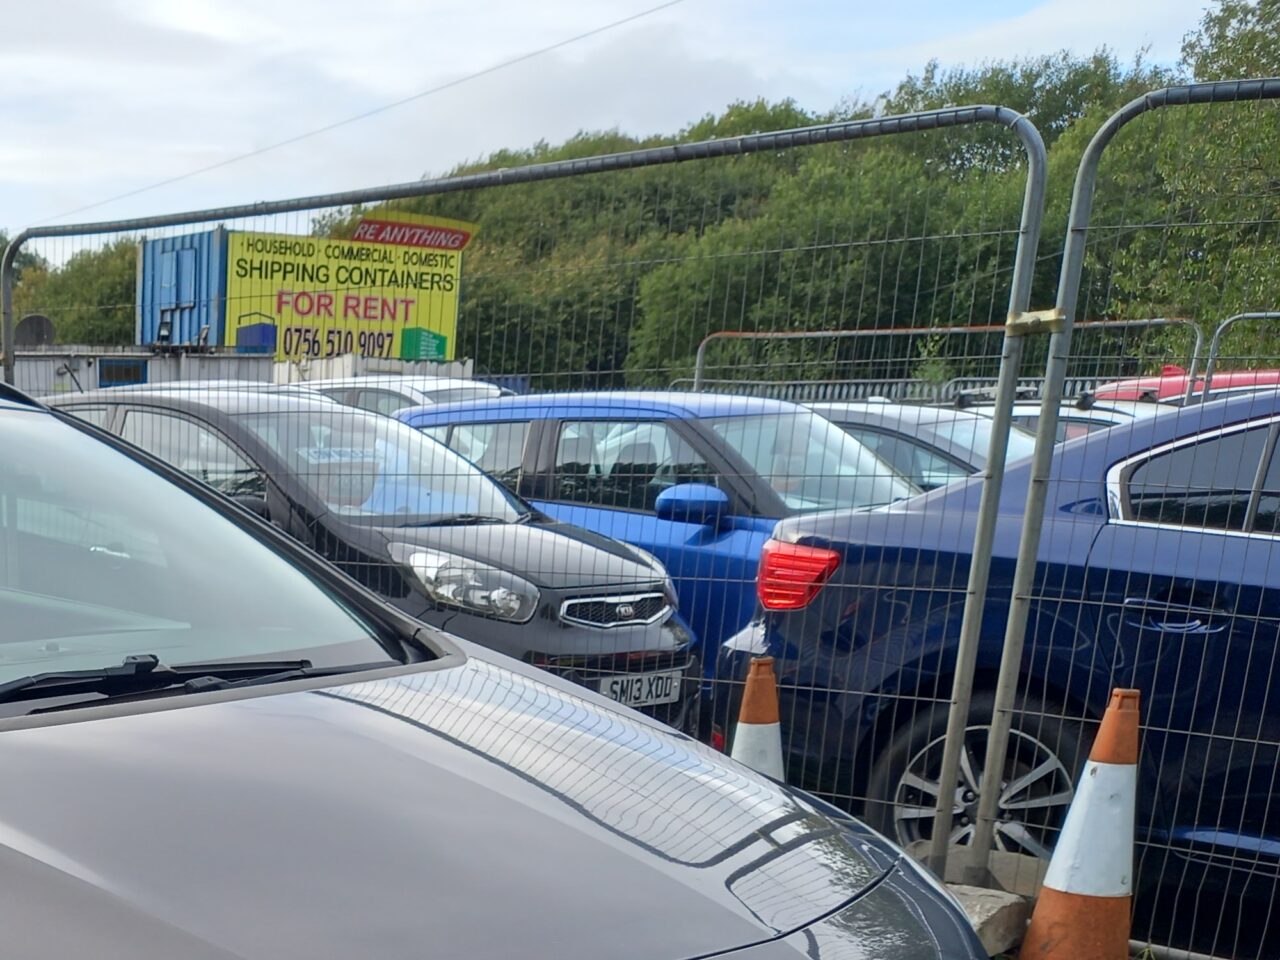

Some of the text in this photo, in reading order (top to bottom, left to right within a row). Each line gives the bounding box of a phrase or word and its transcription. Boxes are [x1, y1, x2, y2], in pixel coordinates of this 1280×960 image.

[378, 226, 464, 248] ANYTHING
[247, 238, 455, 269] HOUSEHOLD COMMERCIAL DOMESTIC
[236, 258, 454, 292] SHIPPING CONTAINERS
[276, 290, 415, 322] FOR RENT
[283, 327, 320, 357] 0756
[326, 329, 354, 357] 510
[358, 330, 394, 360] 9097
